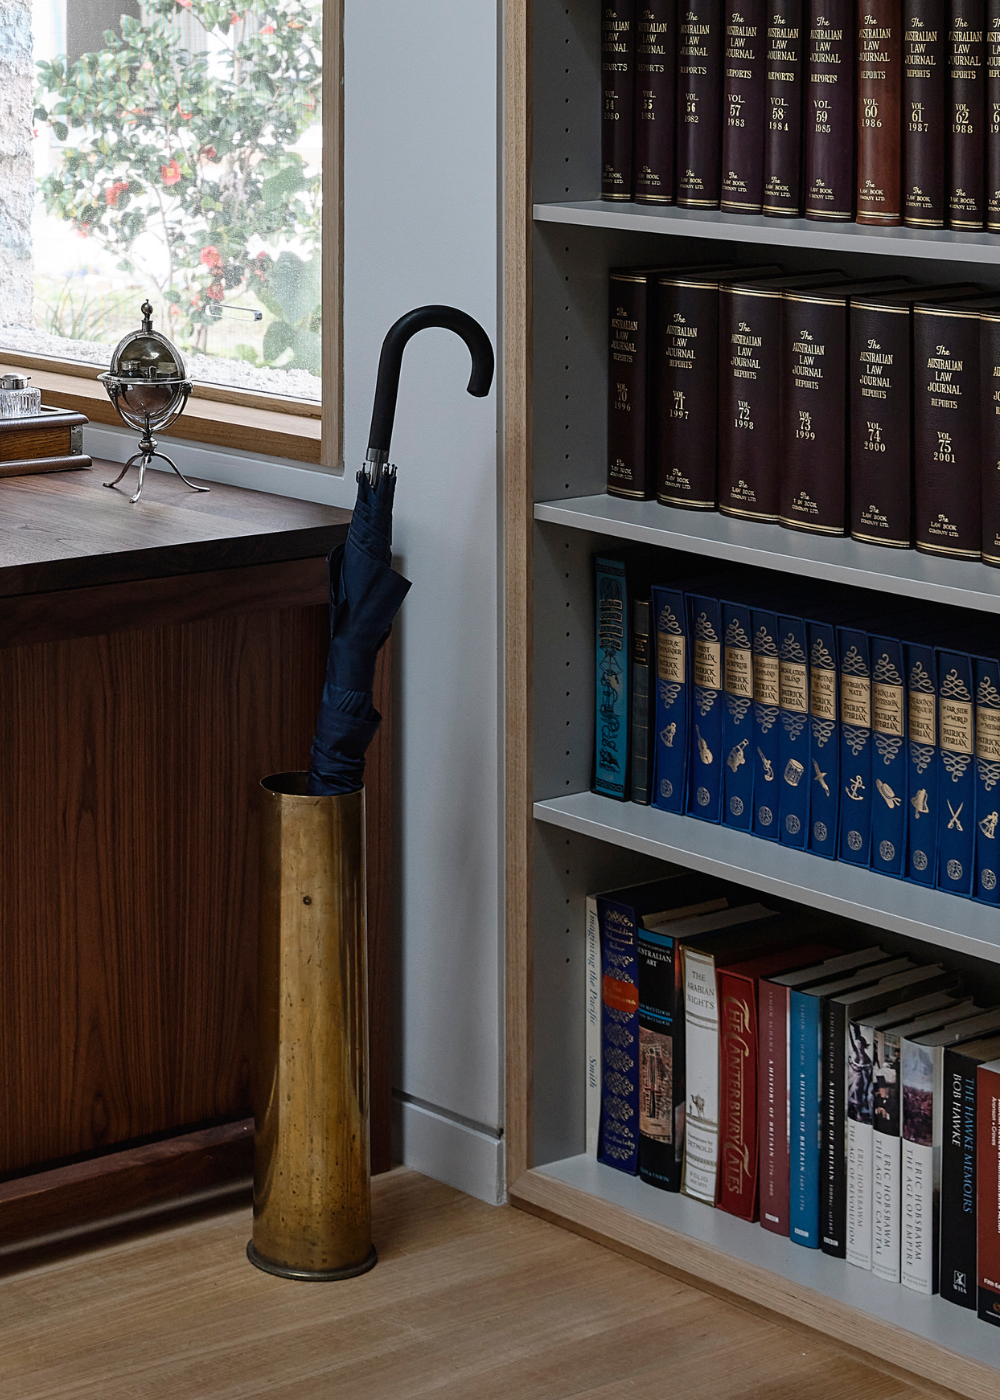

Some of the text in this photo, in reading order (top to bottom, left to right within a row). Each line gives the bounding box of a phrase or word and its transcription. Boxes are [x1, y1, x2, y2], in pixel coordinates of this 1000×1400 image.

[817, 16, 830, 26] The
[911, 18, 924, 28] The
[810, 30, 842, 40] AUSTRALIAN
[905, 31, 937, 41] AUSTRALIAN
[815, 42, 831, 51] LAW
[911, 44, 926, 53] LAW
[810, 53, 841, 63] JOURNAL
[905, 55, 936, 65] JOURNAL
[811, 74, 837, 83] REPORTS
[907, 69, 930, 78] REPORTS
[814, 100, 832, 109] VOL.
[816, 111, 827, 122] 59
[912, 111, 923, 122] 61
[815, 124, 831, 133] 1985
[909, 123, 928, 132] 1987
[936, 345, 950, 356] The
[927, 358, 963, 371] AUSTRALIAN
[935, 371, 952, 381] LAW
[927, 382, 961, 395] JOURNAL
[931, 398, 957, 409] REPORTS
[938, 432, 952, 440] VOL.
[938, 440, 951, 453] 75
[934, 452, 955, 463] 2001
[957, 706, 968, 714] SIDE
[943, 728, 968, 739] PATRICK
[588, 911, 597, 968] Imagining
[692, 971, 705, 981] THE
[688, 981, 714, 996] ARABIAN
[588, 989, 597, 1024] Pacific
[687, 995, 714, 1009] NIGHTS
[724, 996, 752, 1034] THE
[589, 1058, 597, 1088] Smith
[769, 1108, 774, 1117] OF
[952, 1073, 962, 1147] BOB HAWKE
[800, 1120, 805, 1133] OF
[768, 1121, 776, 1157] BRITAIN
[829, 1132, 835, 1141] OF
[962, 1079, 974, 1213] THE HAWKE MEMOIRS
[724, 1141, 752, 1195] TALES
[849, 1168, 855, 1178] OF
[690, 1171, 708, 1182] FOLIO
[875, 1190, 882, 1204] OF
[906, 1204, 913, 1219] OF
[914, 1194, 922, 1260] HOBSBAWM
